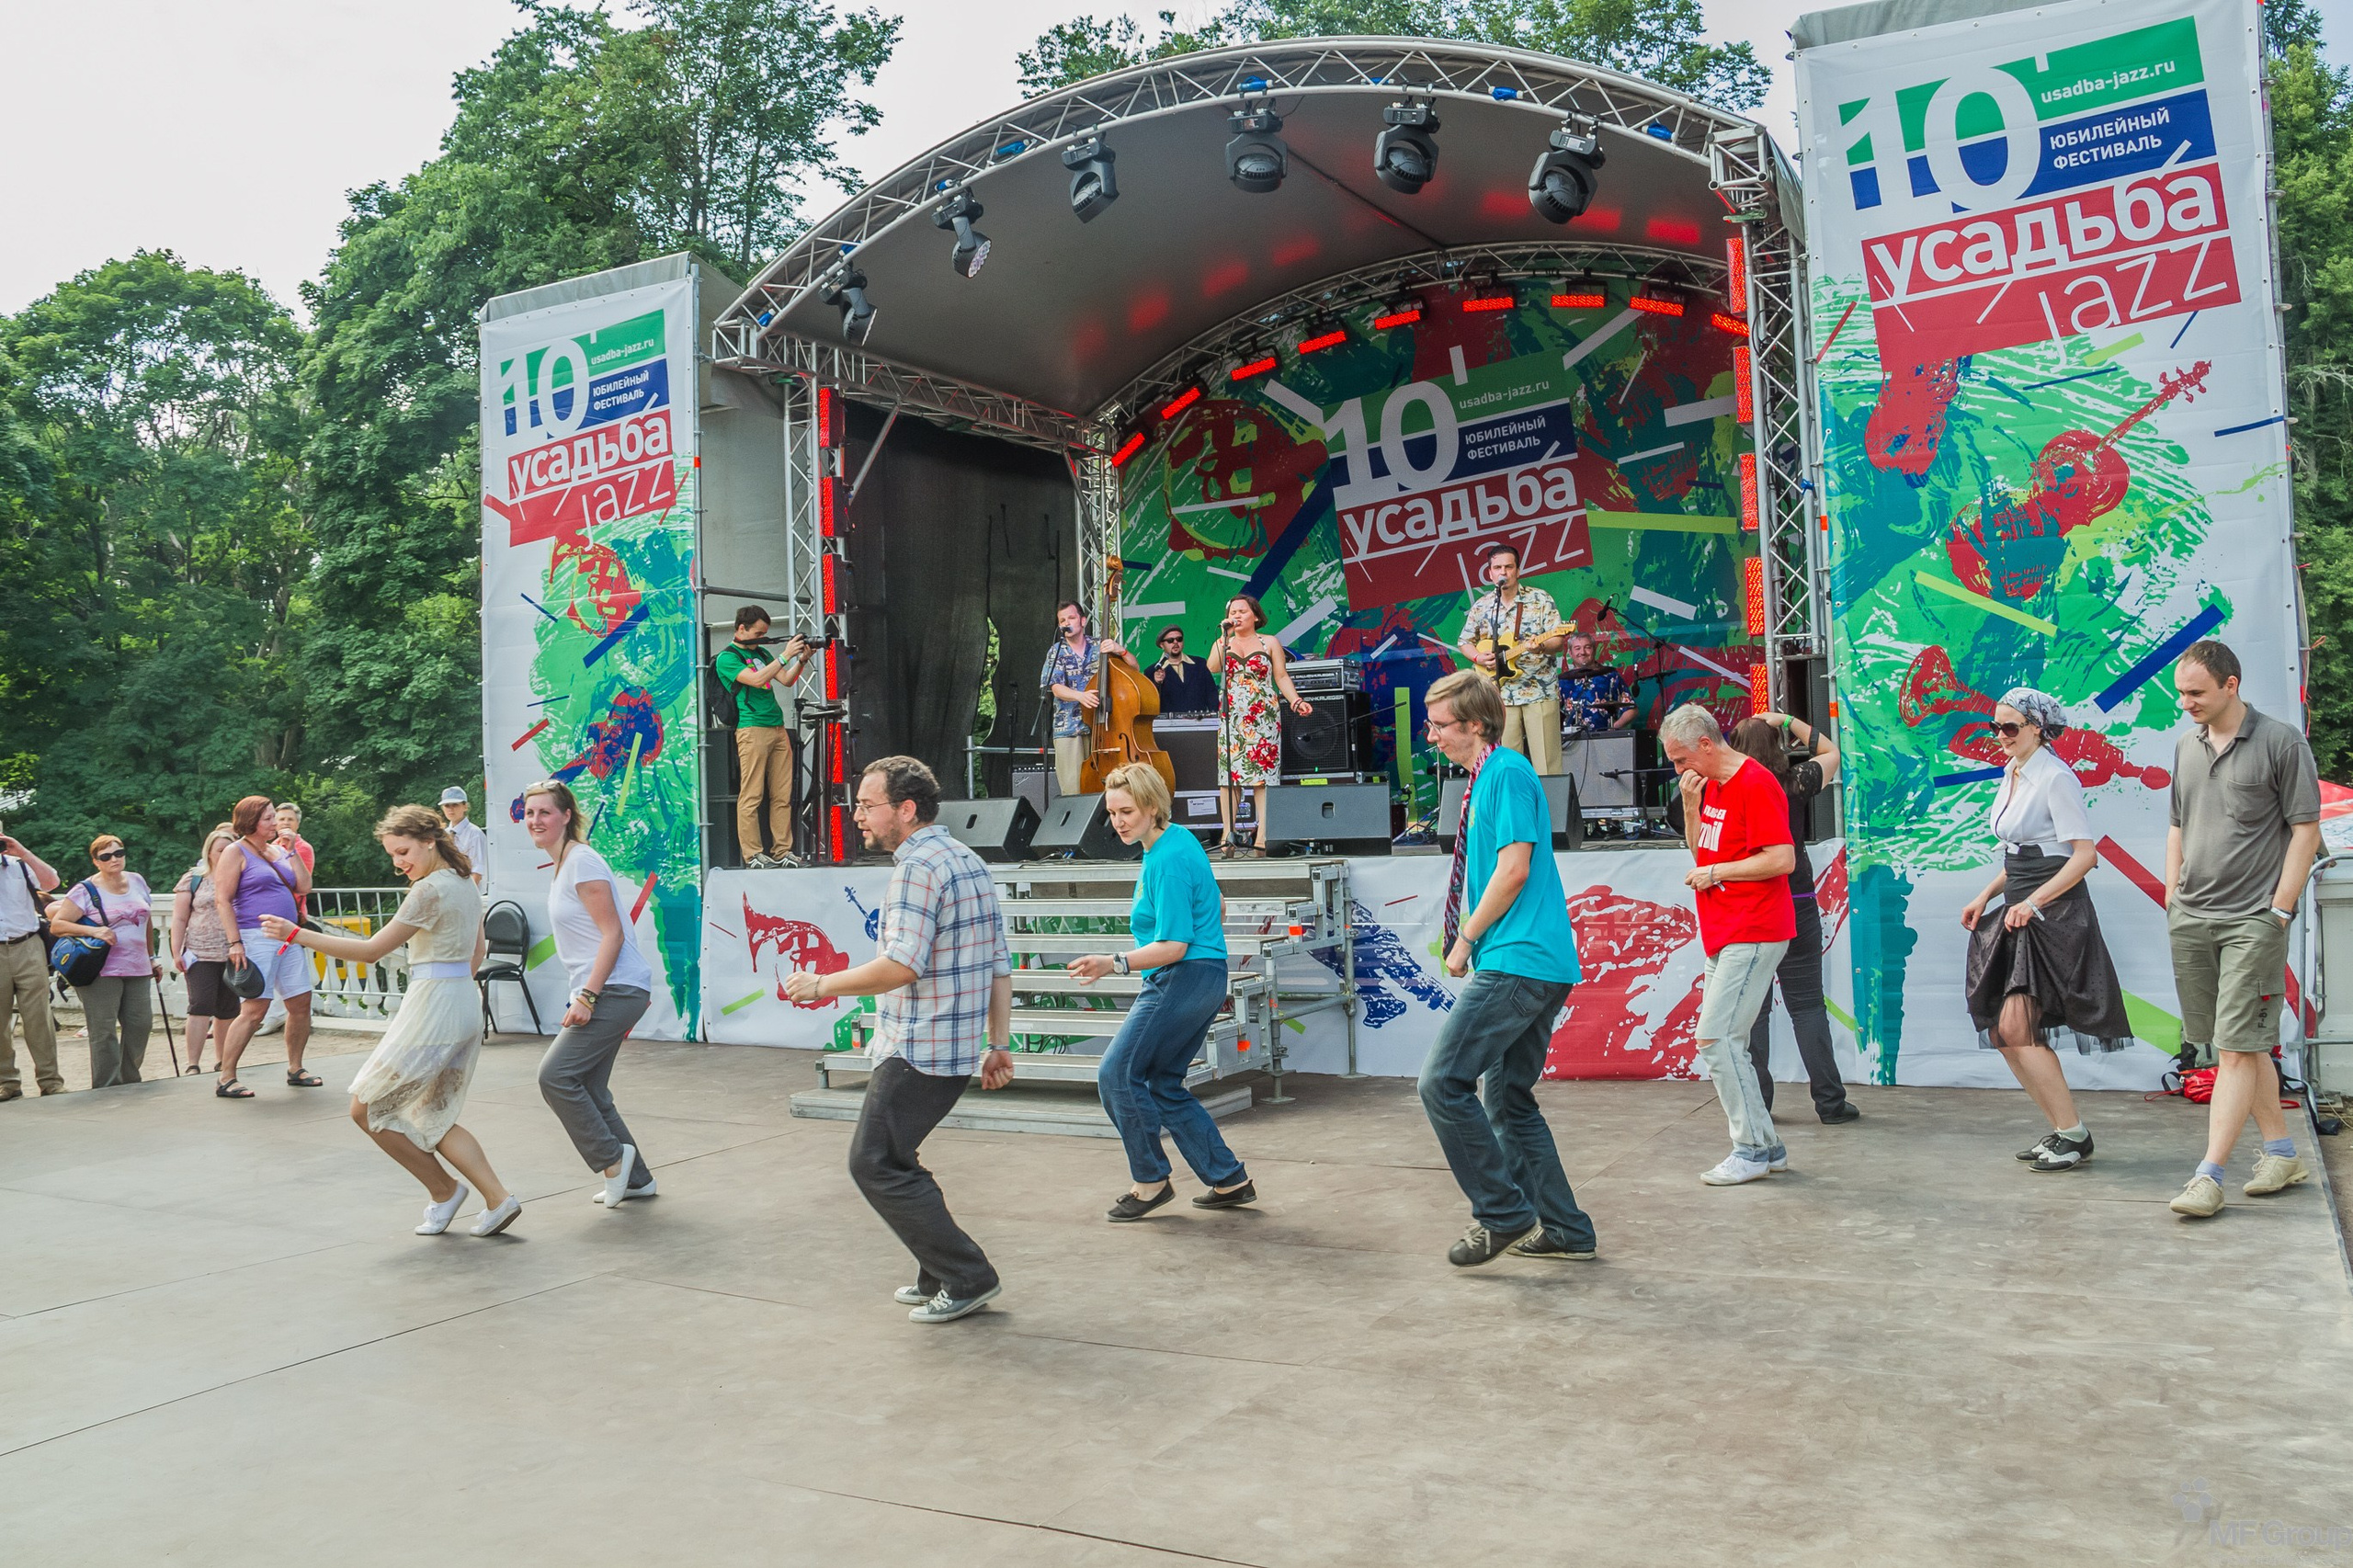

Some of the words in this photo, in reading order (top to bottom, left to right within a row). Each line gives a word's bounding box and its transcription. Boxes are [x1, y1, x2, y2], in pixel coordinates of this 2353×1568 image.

[2040, 58, 2175, 104] usadba-jazz.ru
[1838, 67, 2040, 235] 10
[2050, 107, 2170, 150] ЮБИЛЕЙНЫЙ
[2052, 133, 2162, 171] ФЕСТИВАЛЬ
[1870, 141, 2218, 301] усадьба
[2038, 237, 2227, 373] jazz
[591, 337, 654, 366] usadba-jazz.ru
[500, 337, 589, 456] 10
[593, 369, 650, 398] ЮБИЛЕЙНЫЙ
[593, 389, 645, 412] ФЕСТИВАЛЬ
[1459, 379, 1550, 410] usadba-jazz.ru
[511, 392, 669, 502] усадьба
[1324, 381, 1459, 511] 10
[1464, 415, 1547, 446] ЮБИЛЕЙНЫЙ
[1466, 436, 1541, 460] ФЕСТИВАЛЬ
[581, 460, 671, 551] jazz
[1343, 440, 1578, 555] усадьба
